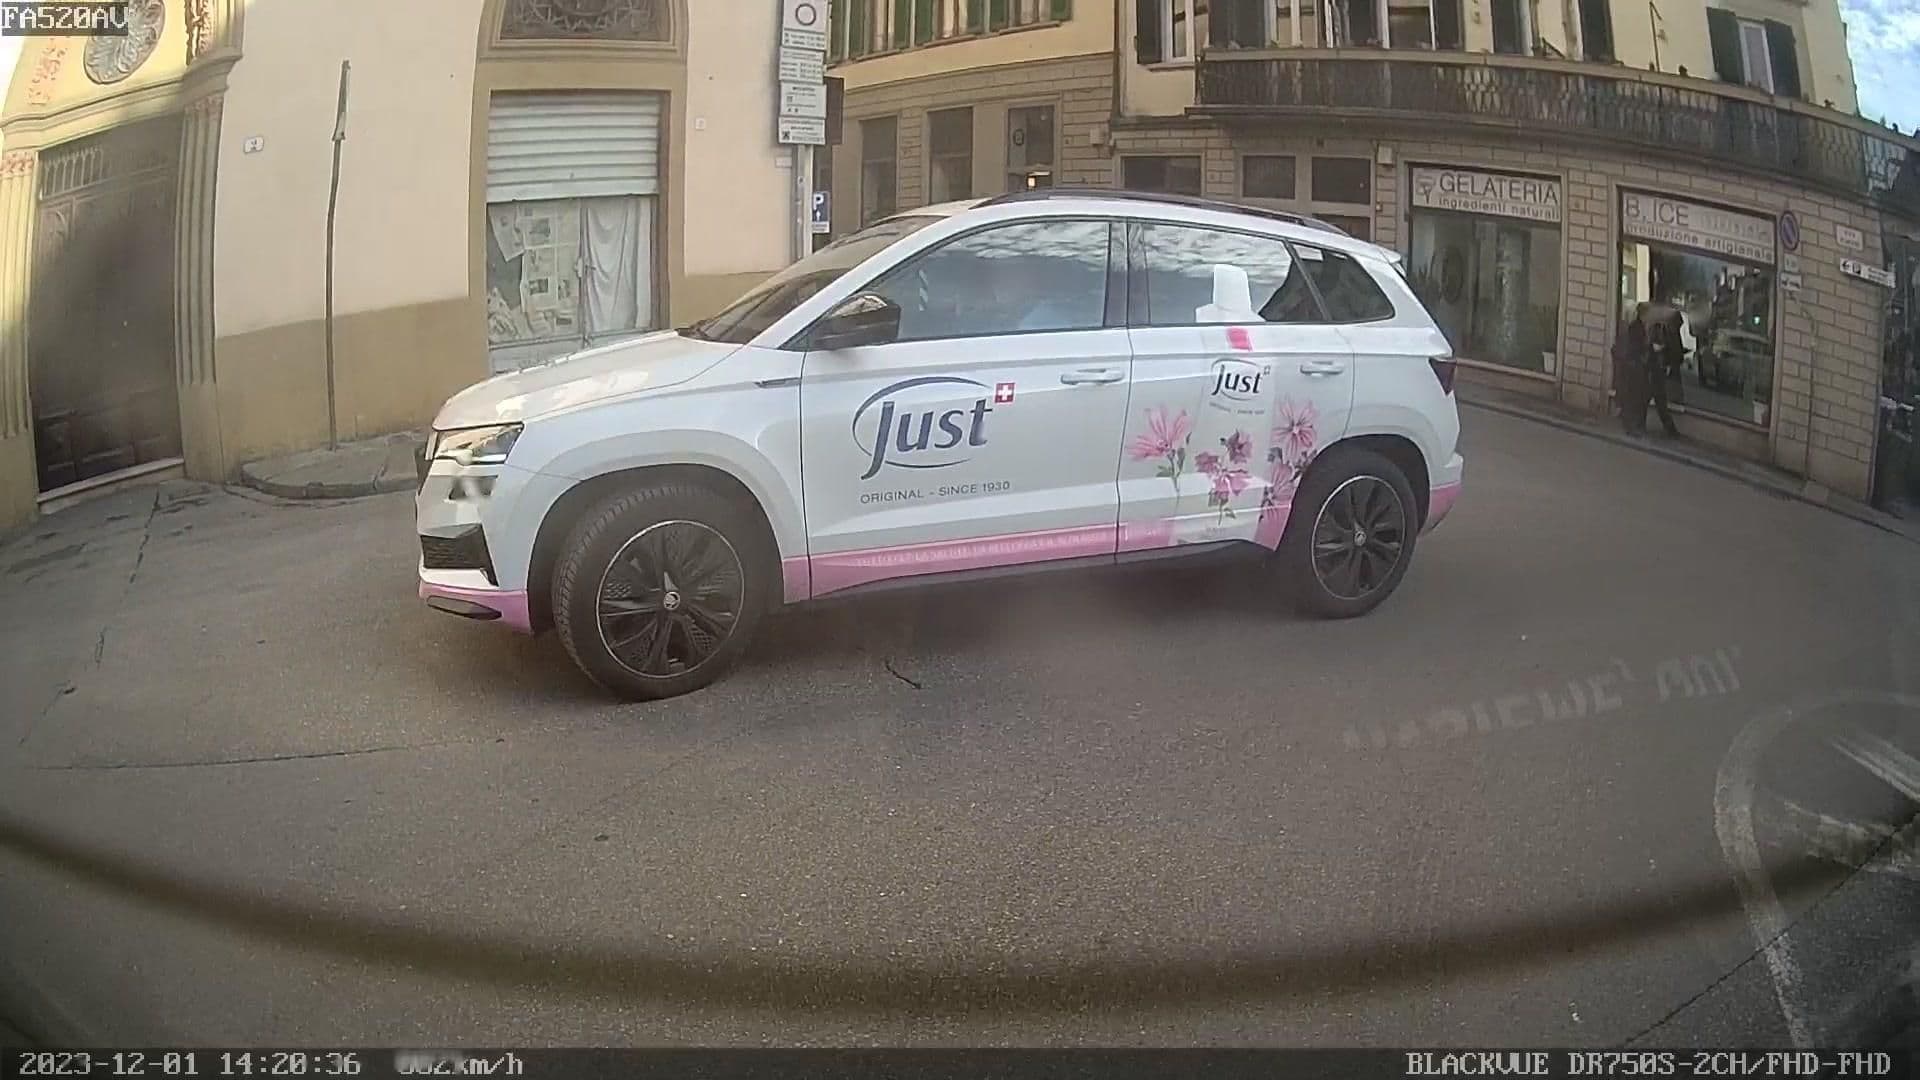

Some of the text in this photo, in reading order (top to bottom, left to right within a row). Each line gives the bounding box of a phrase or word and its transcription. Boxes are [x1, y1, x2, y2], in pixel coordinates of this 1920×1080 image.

[1440, 171, 1558, 204] GELATERIA
[813, 193, 824, 210] P
[1439, 196, 1560, 220] ingredienti naturali
[860, 398, 993, 481] Just
[860, 488, 924, 504] ORIGINAL
[938, 483, 977, 497] SINCE
[982, 480, 1011, 493] 1930
